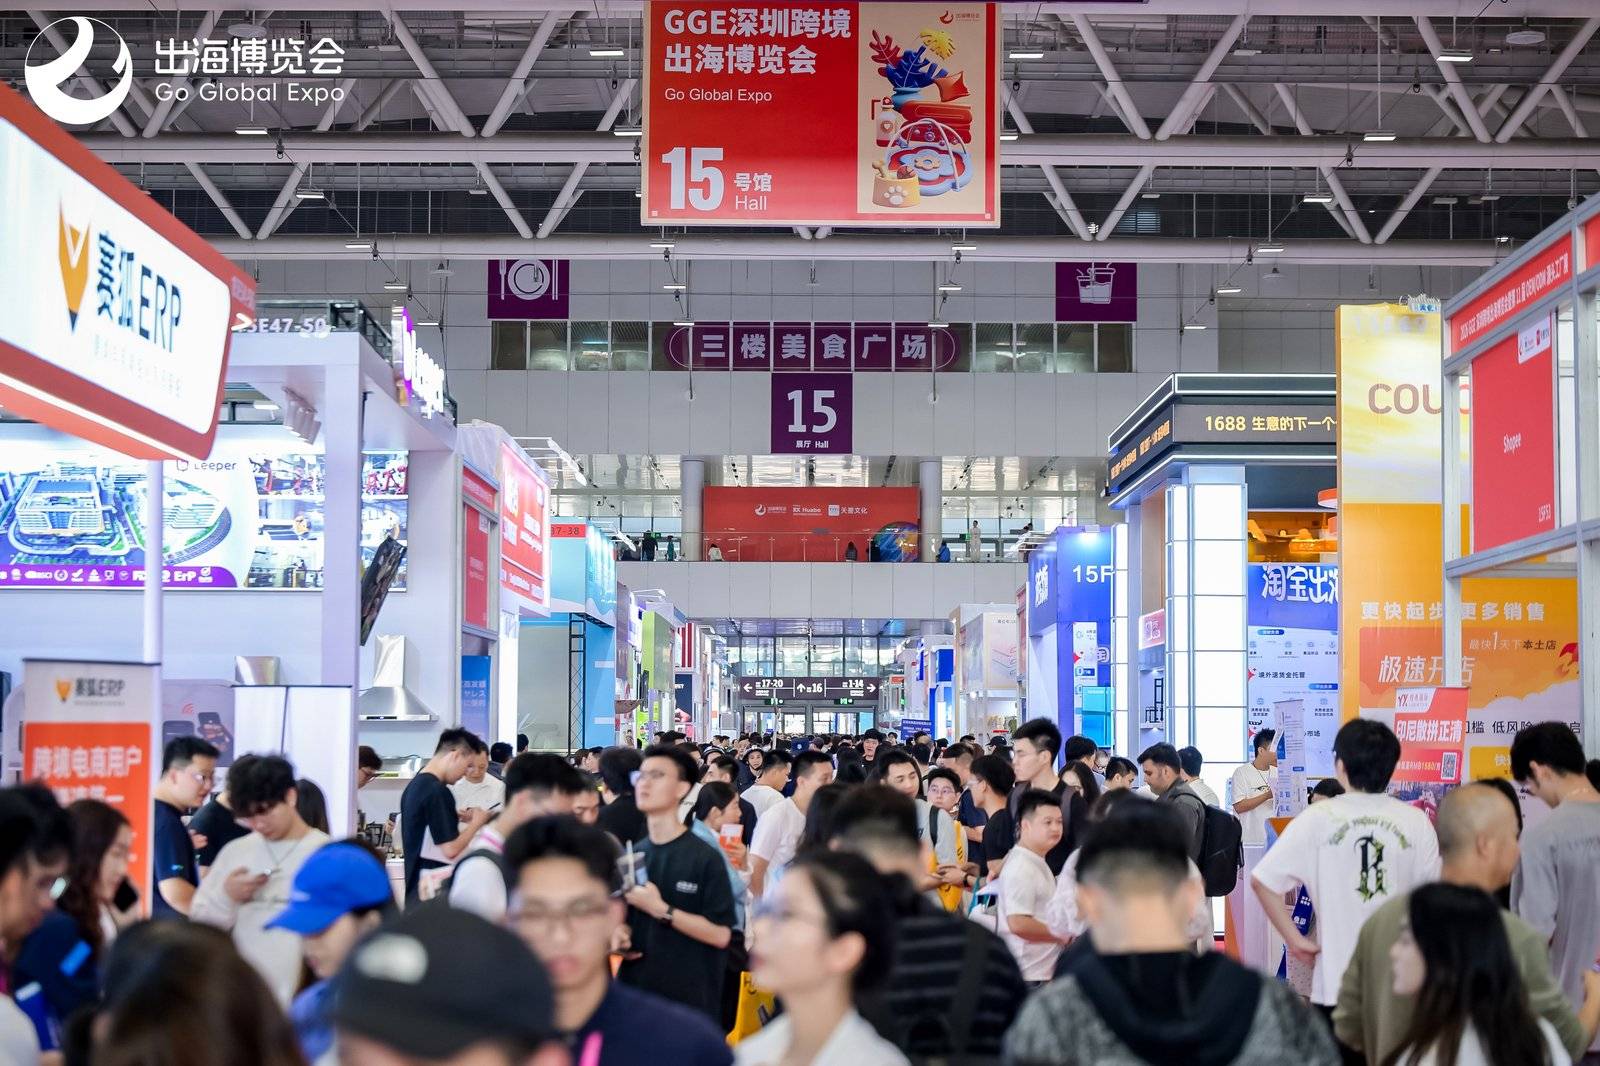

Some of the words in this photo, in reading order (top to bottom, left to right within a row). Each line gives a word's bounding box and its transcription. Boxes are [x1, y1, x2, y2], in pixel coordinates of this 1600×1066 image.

[664, 8, 852, 38] GGE深圳跨境
[664, 44, 817, 74] 出海博览会
[664, 87, 685, 102] Go
[689, 87, 733, 102] Global
[737, 88, 772, 105] Expo
[661, 147, 725, 211] 15
[733, 173, 772, 193] 号馆
[735, 195, 768, 211] Hall
[238, 317, 327, 334] 5E47-50
[700, 333, 927, 361] 三楼美食广场
[1368, 383, 1470, 415] COU
[787, 389, 837, 434] 15
[1205, 416, 1246, 431] 1688
[1252, 415, 1337, 432] 生意的下一个
[815, 440, 829, 449] Hall
[1072, 565, 1115, 583] 15F
[812, 683, 822, 692] 16
